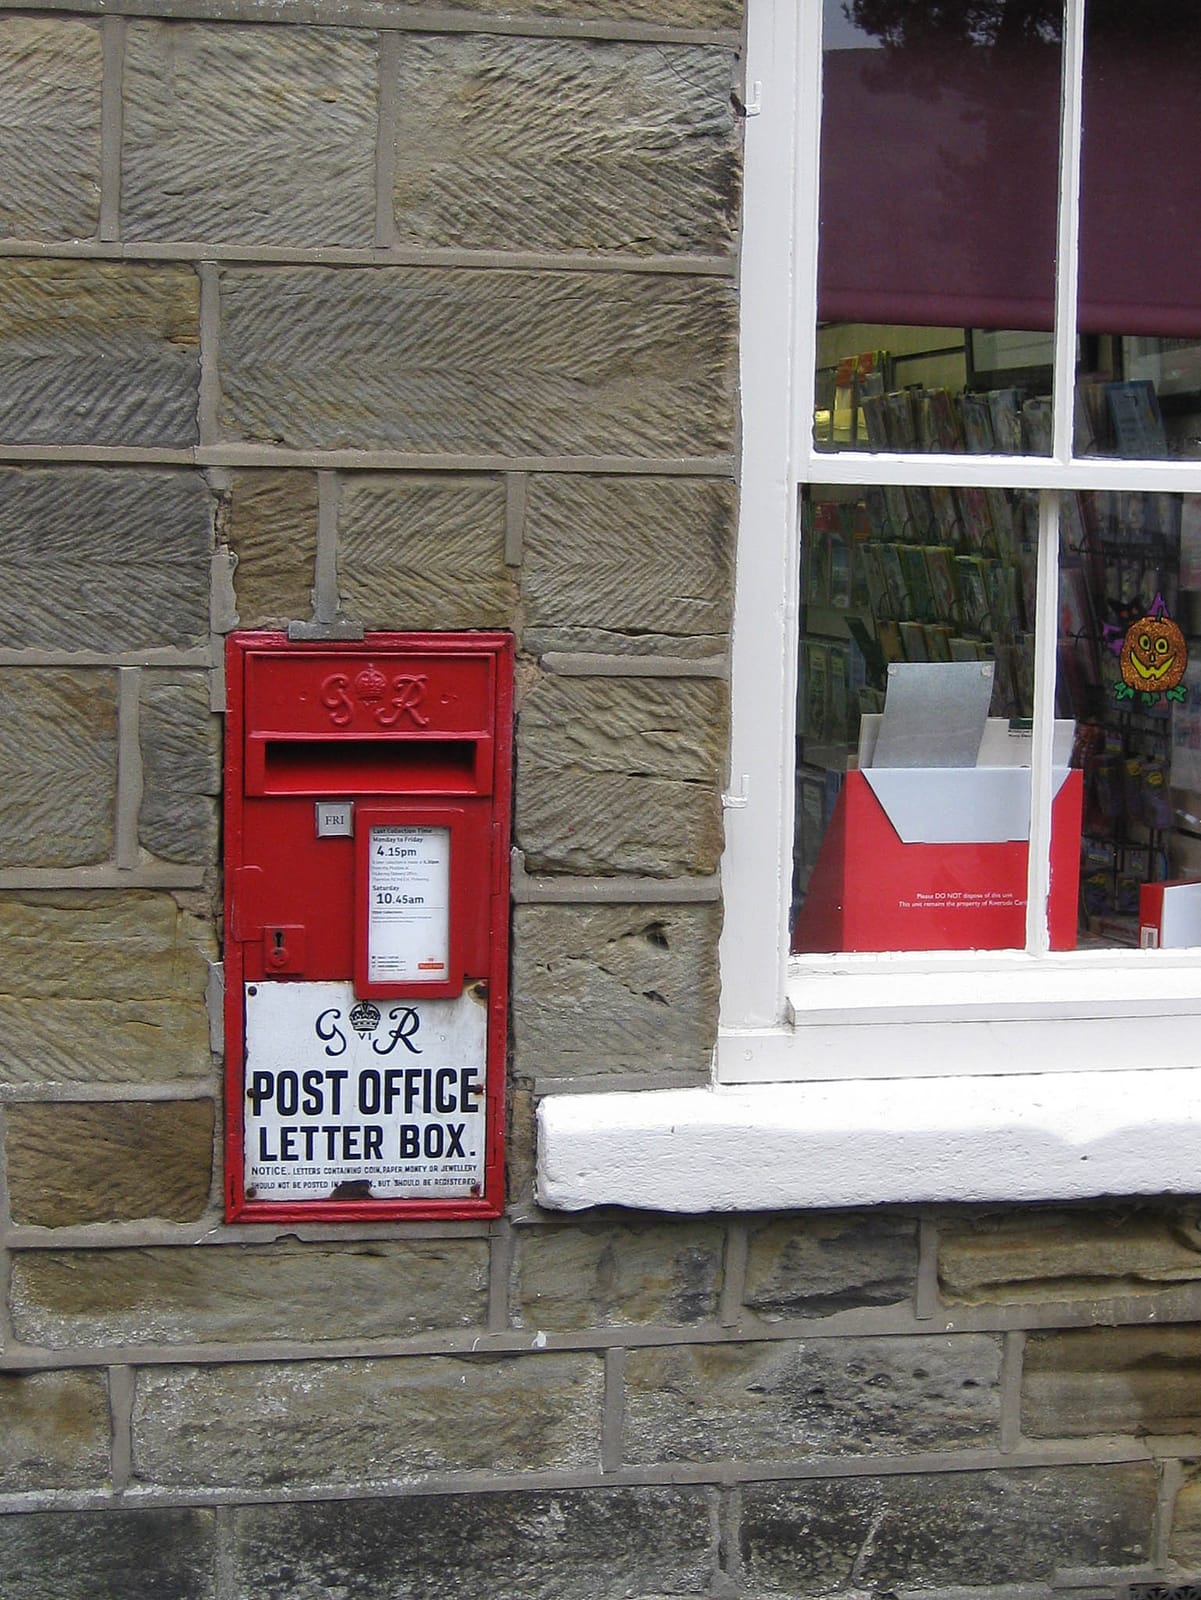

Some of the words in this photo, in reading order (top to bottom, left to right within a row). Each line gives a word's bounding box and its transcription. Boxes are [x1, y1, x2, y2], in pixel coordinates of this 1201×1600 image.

[325, 815, 345, 825] FRI
[377, 845, 417, 858] 4.15pm
[376, 893, 425, 905] 10.45am
[316, 1008, 347, 1056] G
[373, 1006, 423, 1055] R
[358, 1032, 373, 1041] VI
[252, 1070, 348, 1116] POST
[359, 1068, 479, 1114] OFFICE
[259, 1125, 384, 1161] LETTER
[400, 1123, 476, 1159] BOX.
[252, 1166, 291, 1176] NOTICE.
[293, 1167, 321, 1175] LETTERS
[324, 1167, 362, 1175] CONTAINING
[405, 1165, 427, 1173] MONEY
[441, 1164, 477, 1172] JEWELLERY
[293, 1181, 302, 1189] BE
[303, 1181, 329, 1189] POSTED
